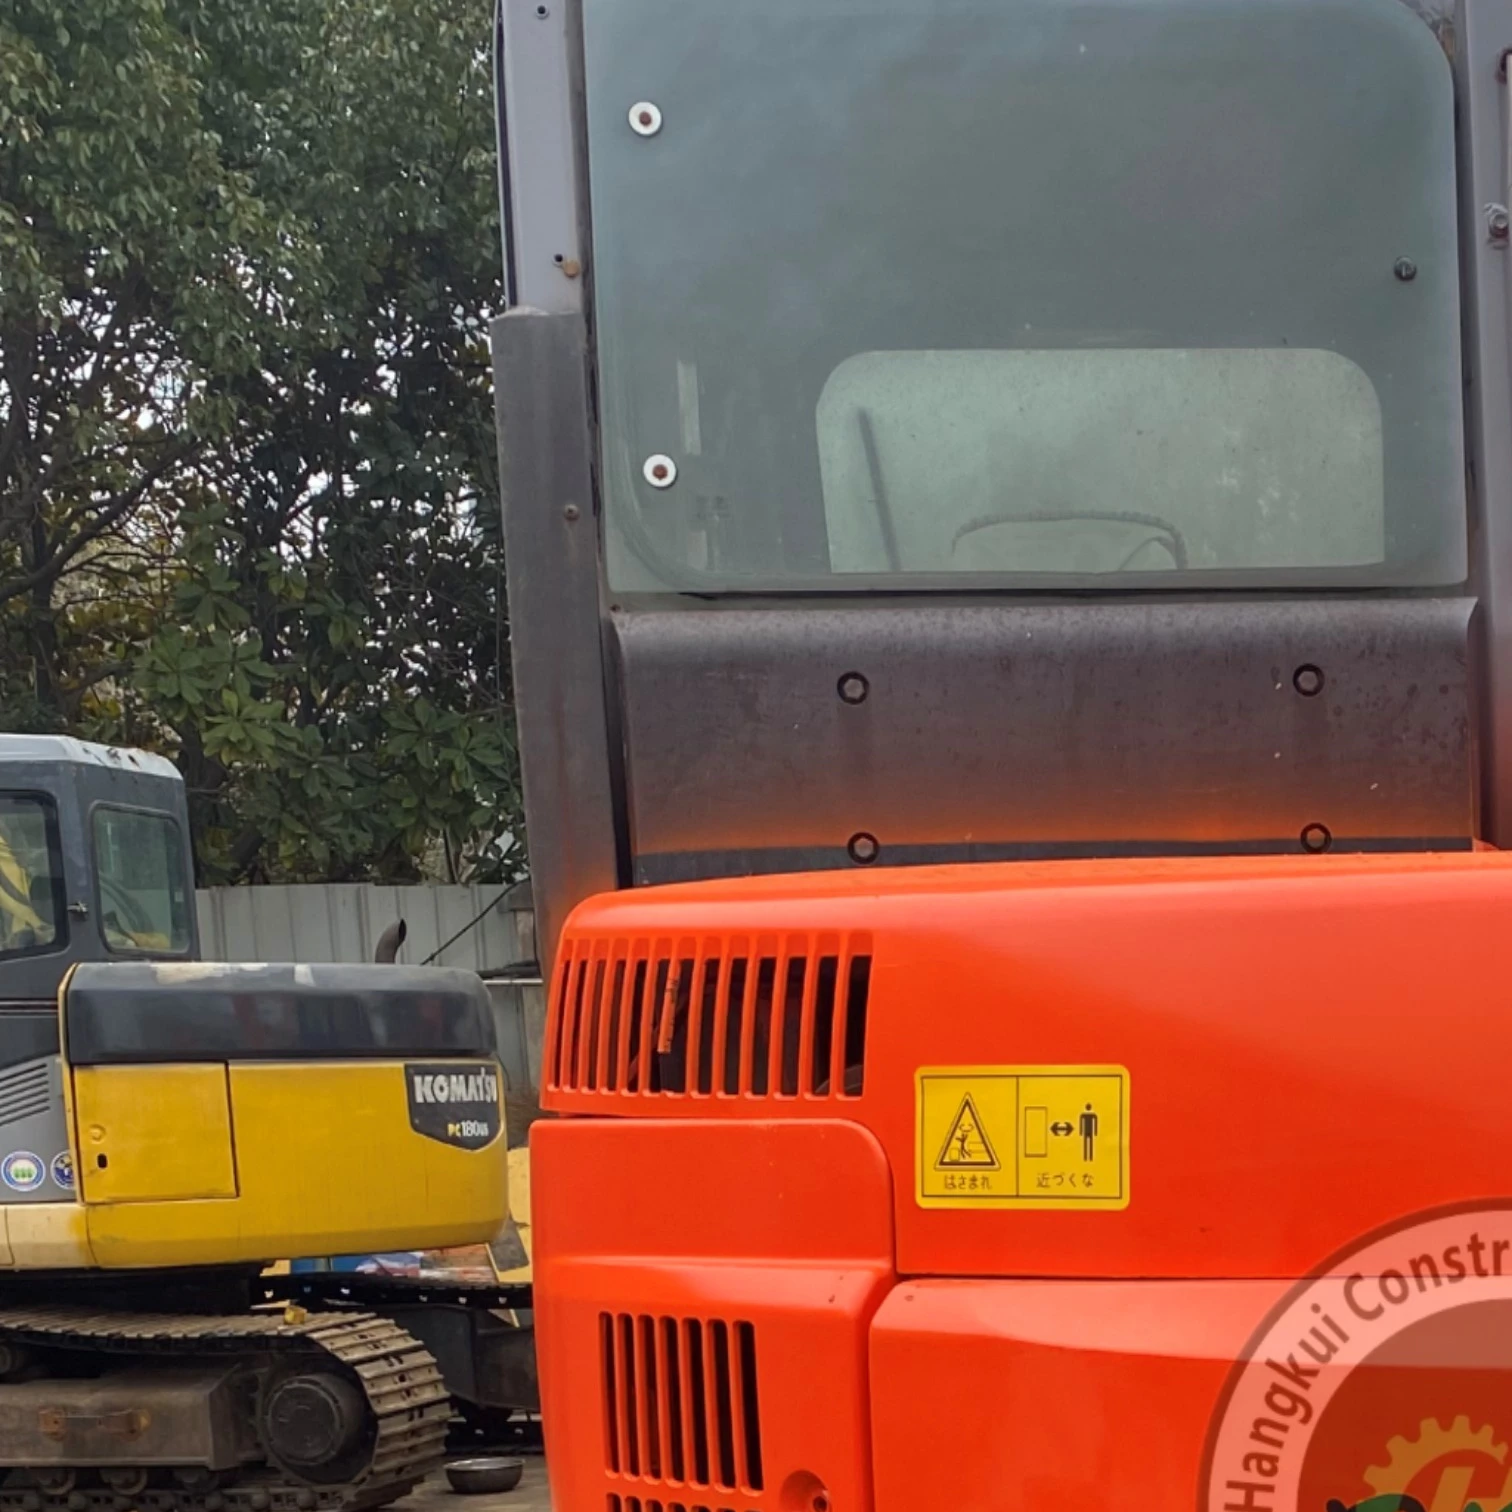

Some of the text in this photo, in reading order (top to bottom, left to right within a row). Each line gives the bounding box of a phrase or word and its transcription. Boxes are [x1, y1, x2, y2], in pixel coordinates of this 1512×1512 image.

[944, 1175, 992, 1190] はさまれ
[1036, 1172, 1094, 1188] 近づくな
